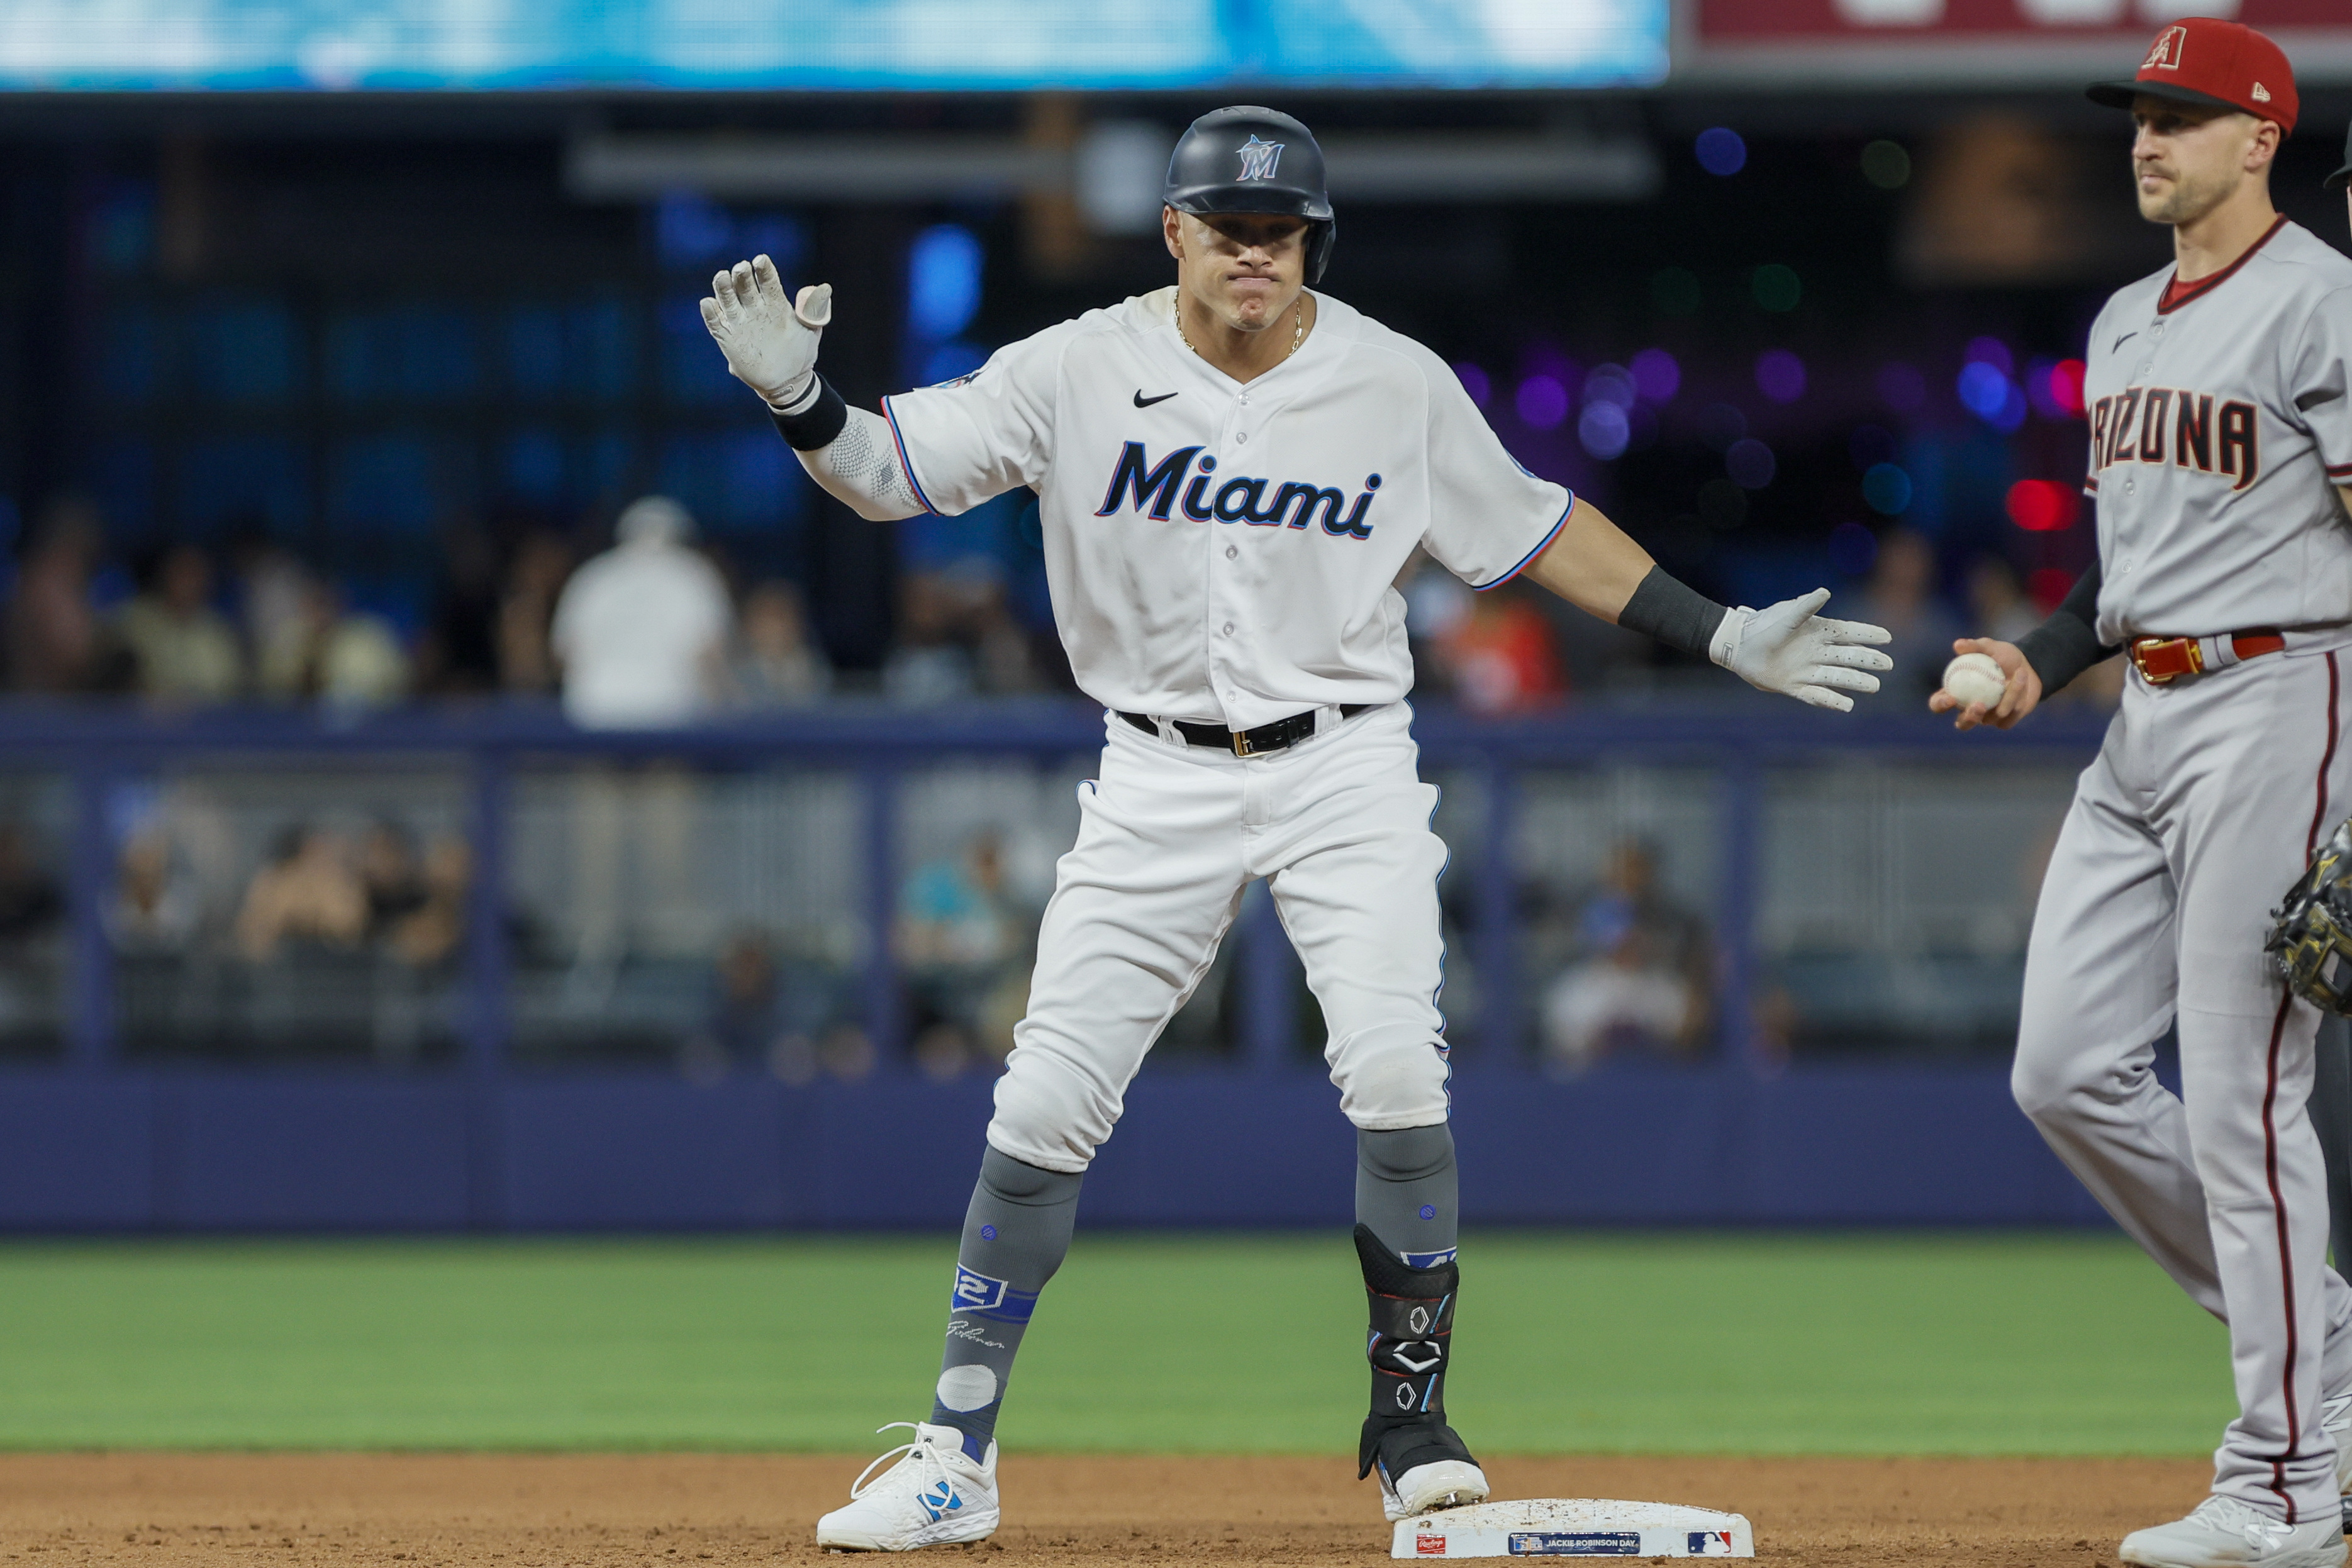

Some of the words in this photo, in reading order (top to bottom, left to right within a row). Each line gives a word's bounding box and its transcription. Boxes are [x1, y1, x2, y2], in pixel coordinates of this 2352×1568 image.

[2088, 386, 2260, 493] RIZONA
[1094, 441, 1383, 541] Miami
[1576, 1539, 1618, 1547] ROBINSON
